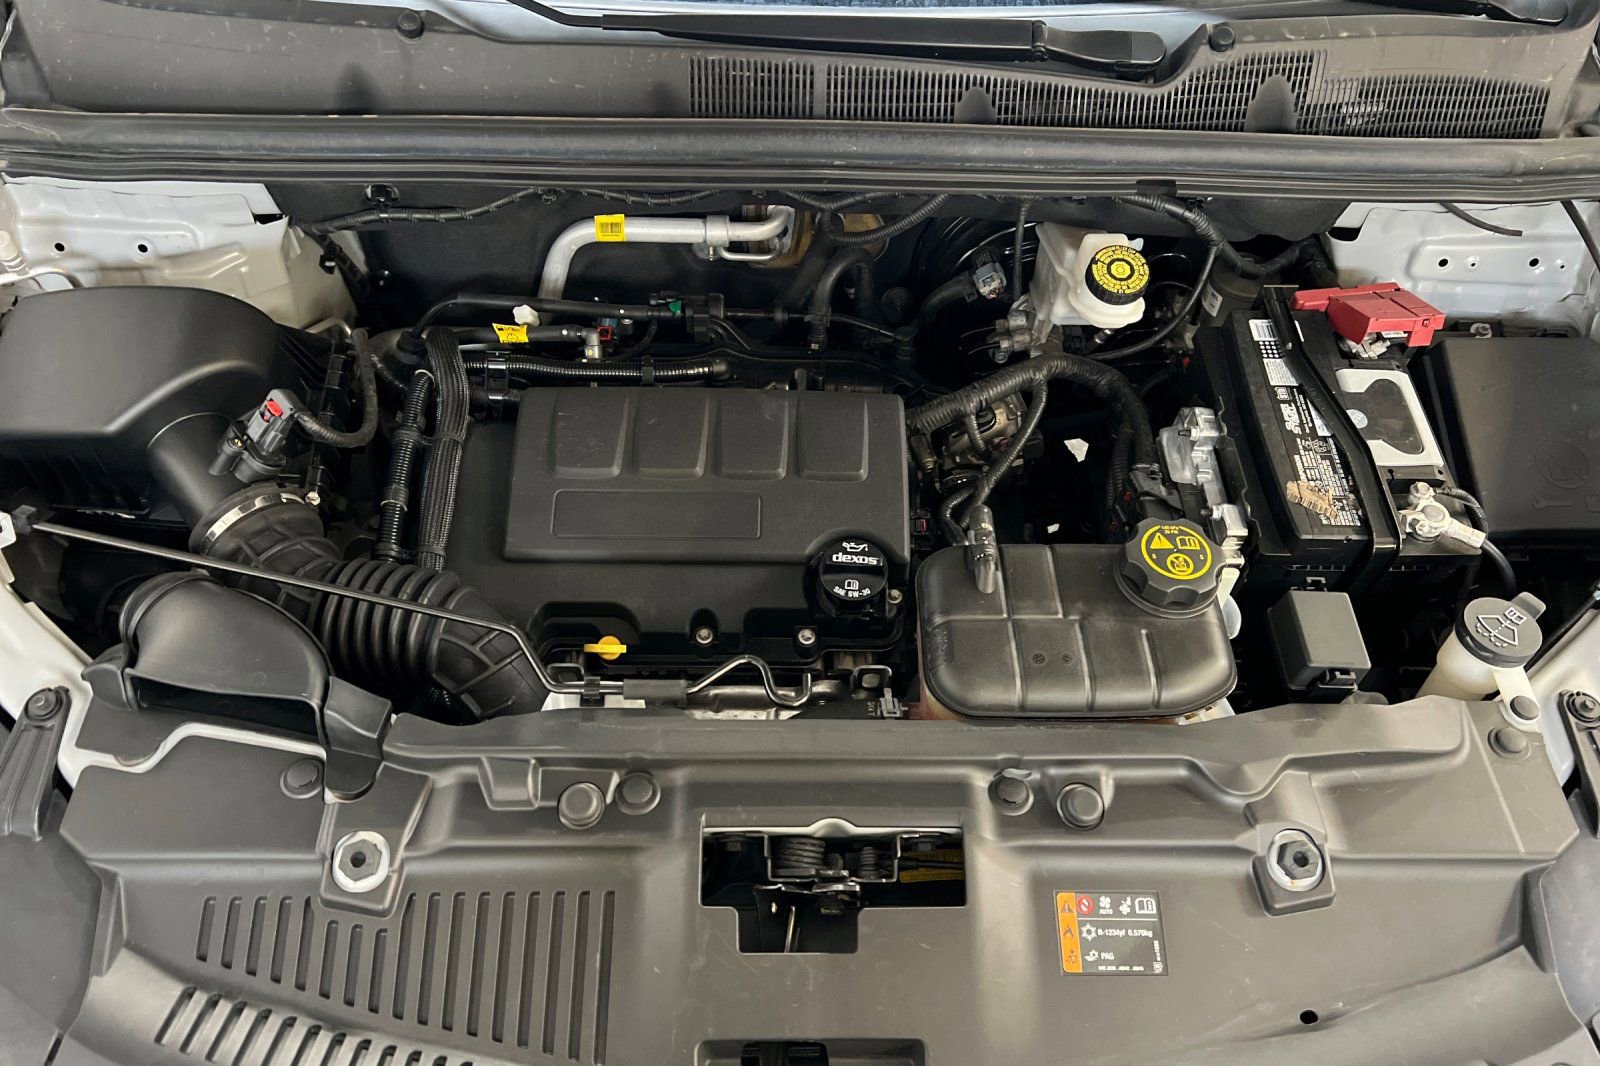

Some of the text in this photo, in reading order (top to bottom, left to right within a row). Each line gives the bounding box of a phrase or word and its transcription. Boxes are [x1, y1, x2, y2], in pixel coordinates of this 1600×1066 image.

[832, 552, 879, 565] dexos
[833, 586, 871, 598] SAE 5W-30
[1100, 952, 1115, 960] PAG
